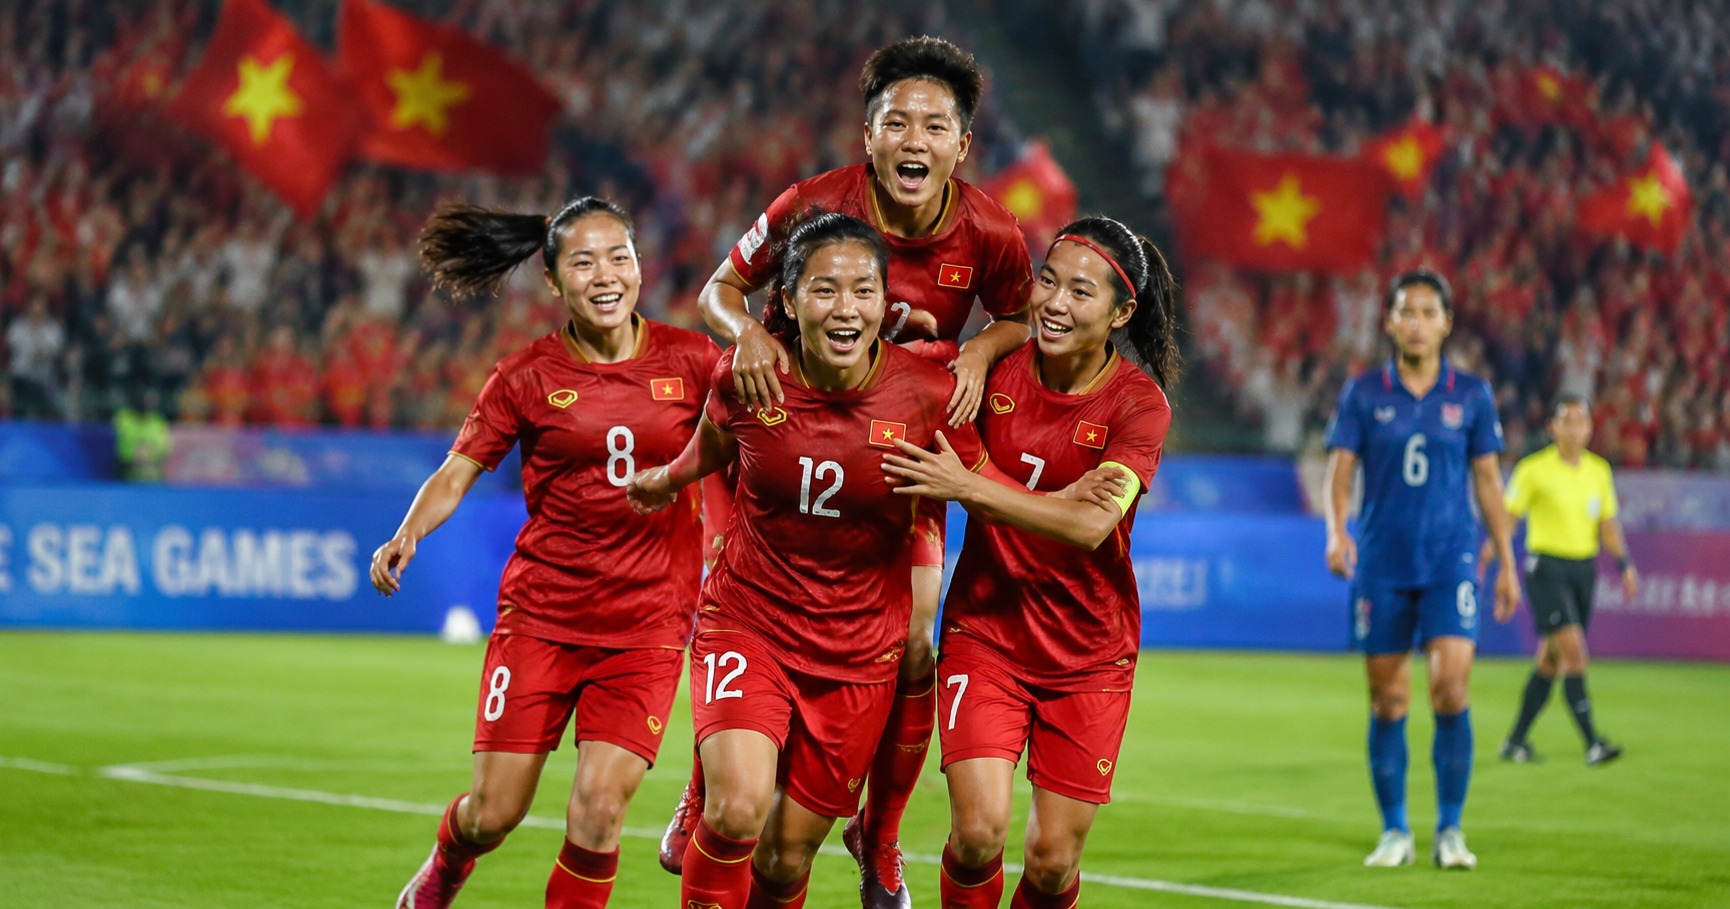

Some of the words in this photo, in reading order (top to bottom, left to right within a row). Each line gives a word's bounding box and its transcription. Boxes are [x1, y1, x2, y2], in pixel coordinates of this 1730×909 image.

[606, 425, 635, 487] 8
[1020, 452, 1046, 492] 7
[1402, 432, 1429, 487] 6
[798, 456, 844, 518] 12
[28, 523, 141, 595] SEA
[155, 526, 359, 599] GAMES
[1456, 580, 1477, 618] 6
[484, 665, 512, 722] 8
[703, 651, 748, 706] 12
[946, 674, 969, 731] 7
